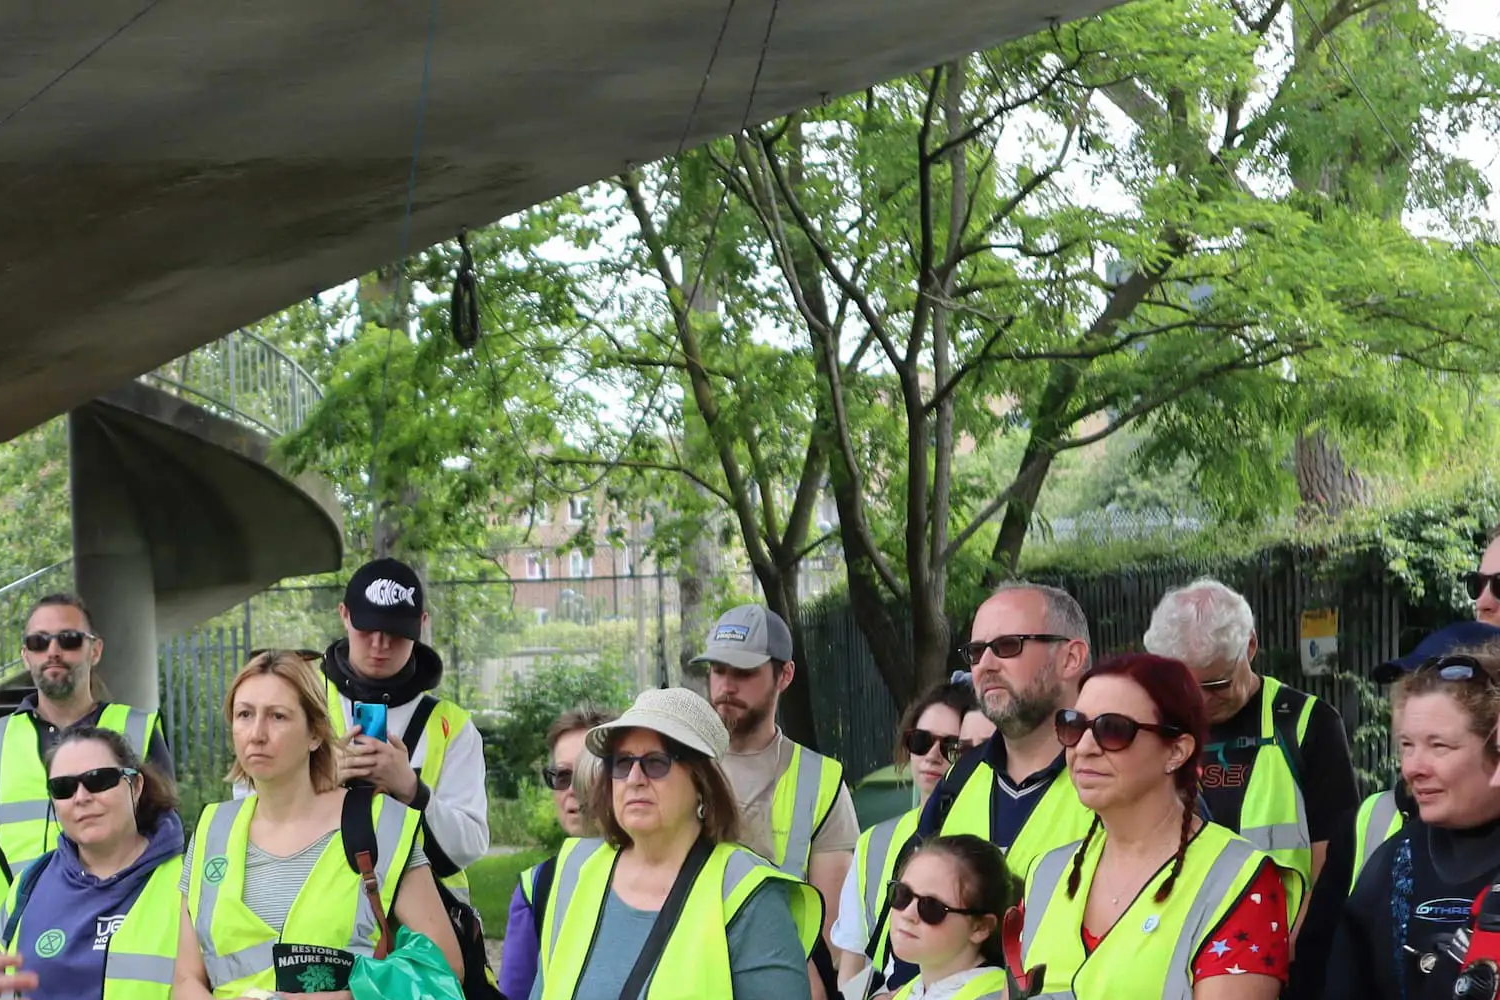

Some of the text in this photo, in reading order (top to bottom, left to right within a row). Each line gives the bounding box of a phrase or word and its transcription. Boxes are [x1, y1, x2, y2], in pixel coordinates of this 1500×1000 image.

[292, 945, 339, 957] RESTORE
[278, 954, 353, 968] NATURE NOW
